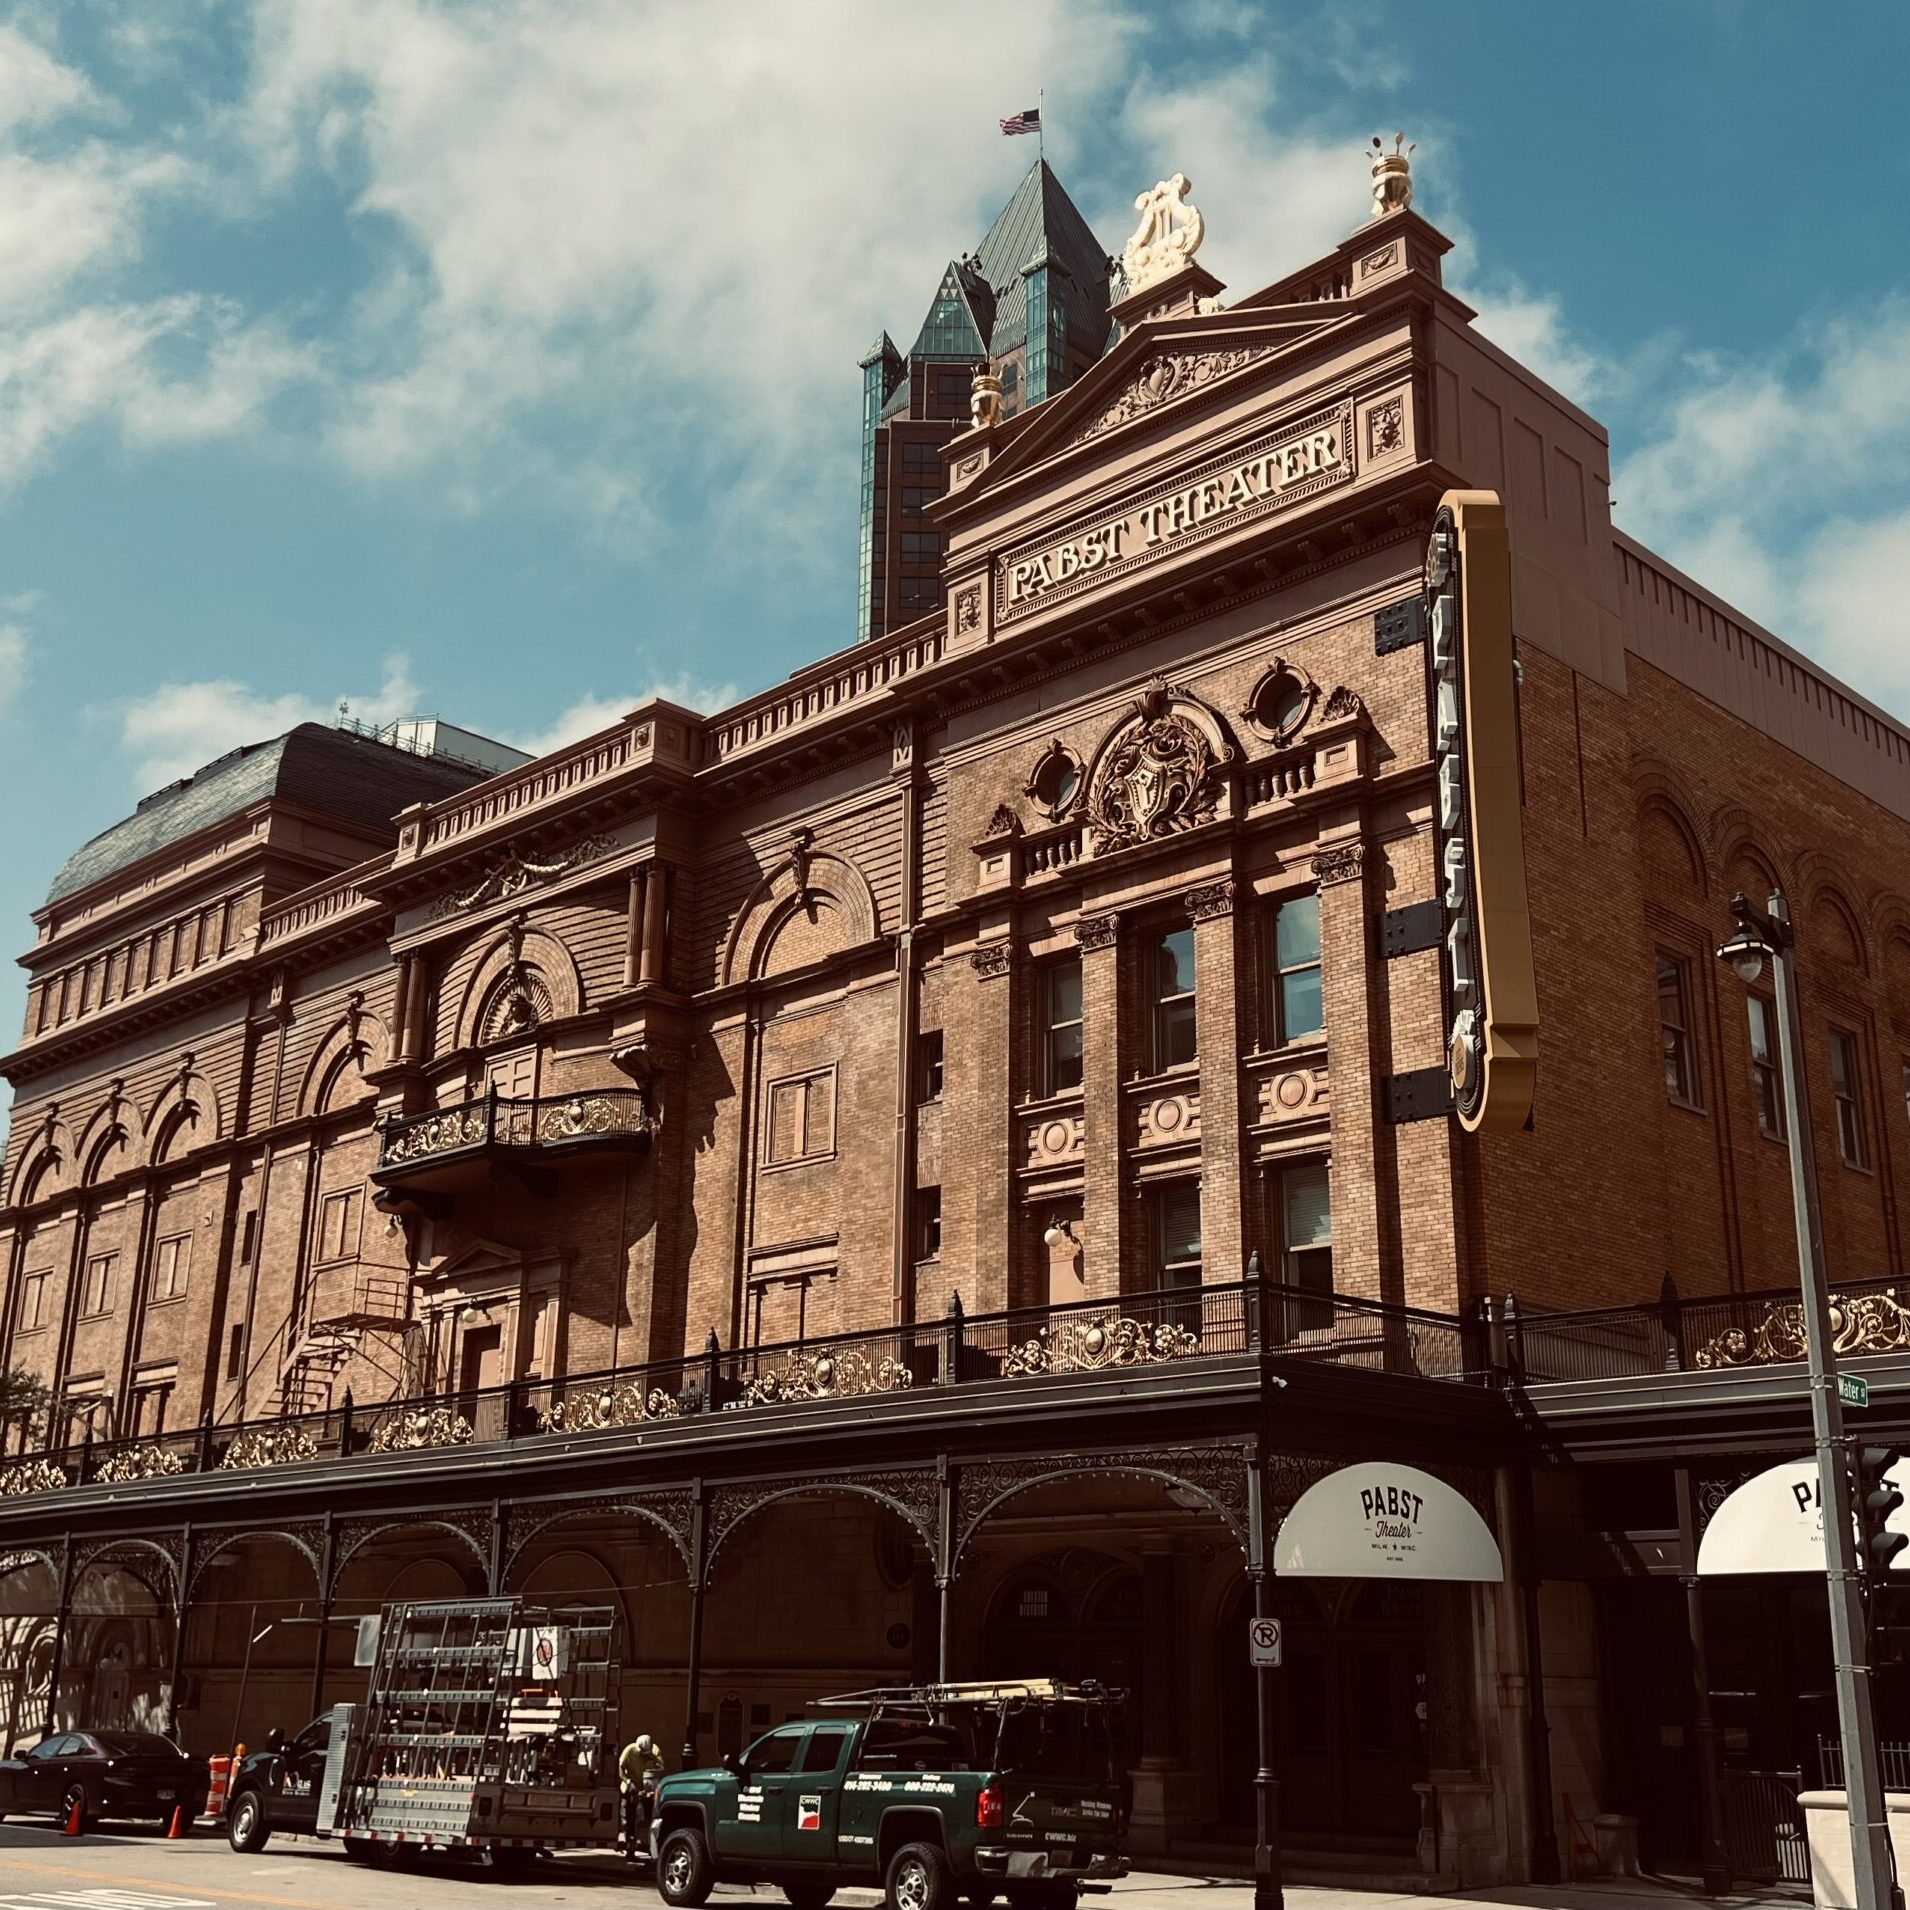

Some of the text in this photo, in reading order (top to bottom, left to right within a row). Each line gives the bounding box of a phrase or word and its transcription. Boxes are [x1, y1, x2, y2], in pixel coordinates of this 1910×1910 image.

[1008, 429, 1341, 602] PABST THEATER
[1837, 1377, 1859, 1400] Water
[1360, 1486, 1424, 1524] PABST
[1375, 1520, 1412, 1538] Theater
